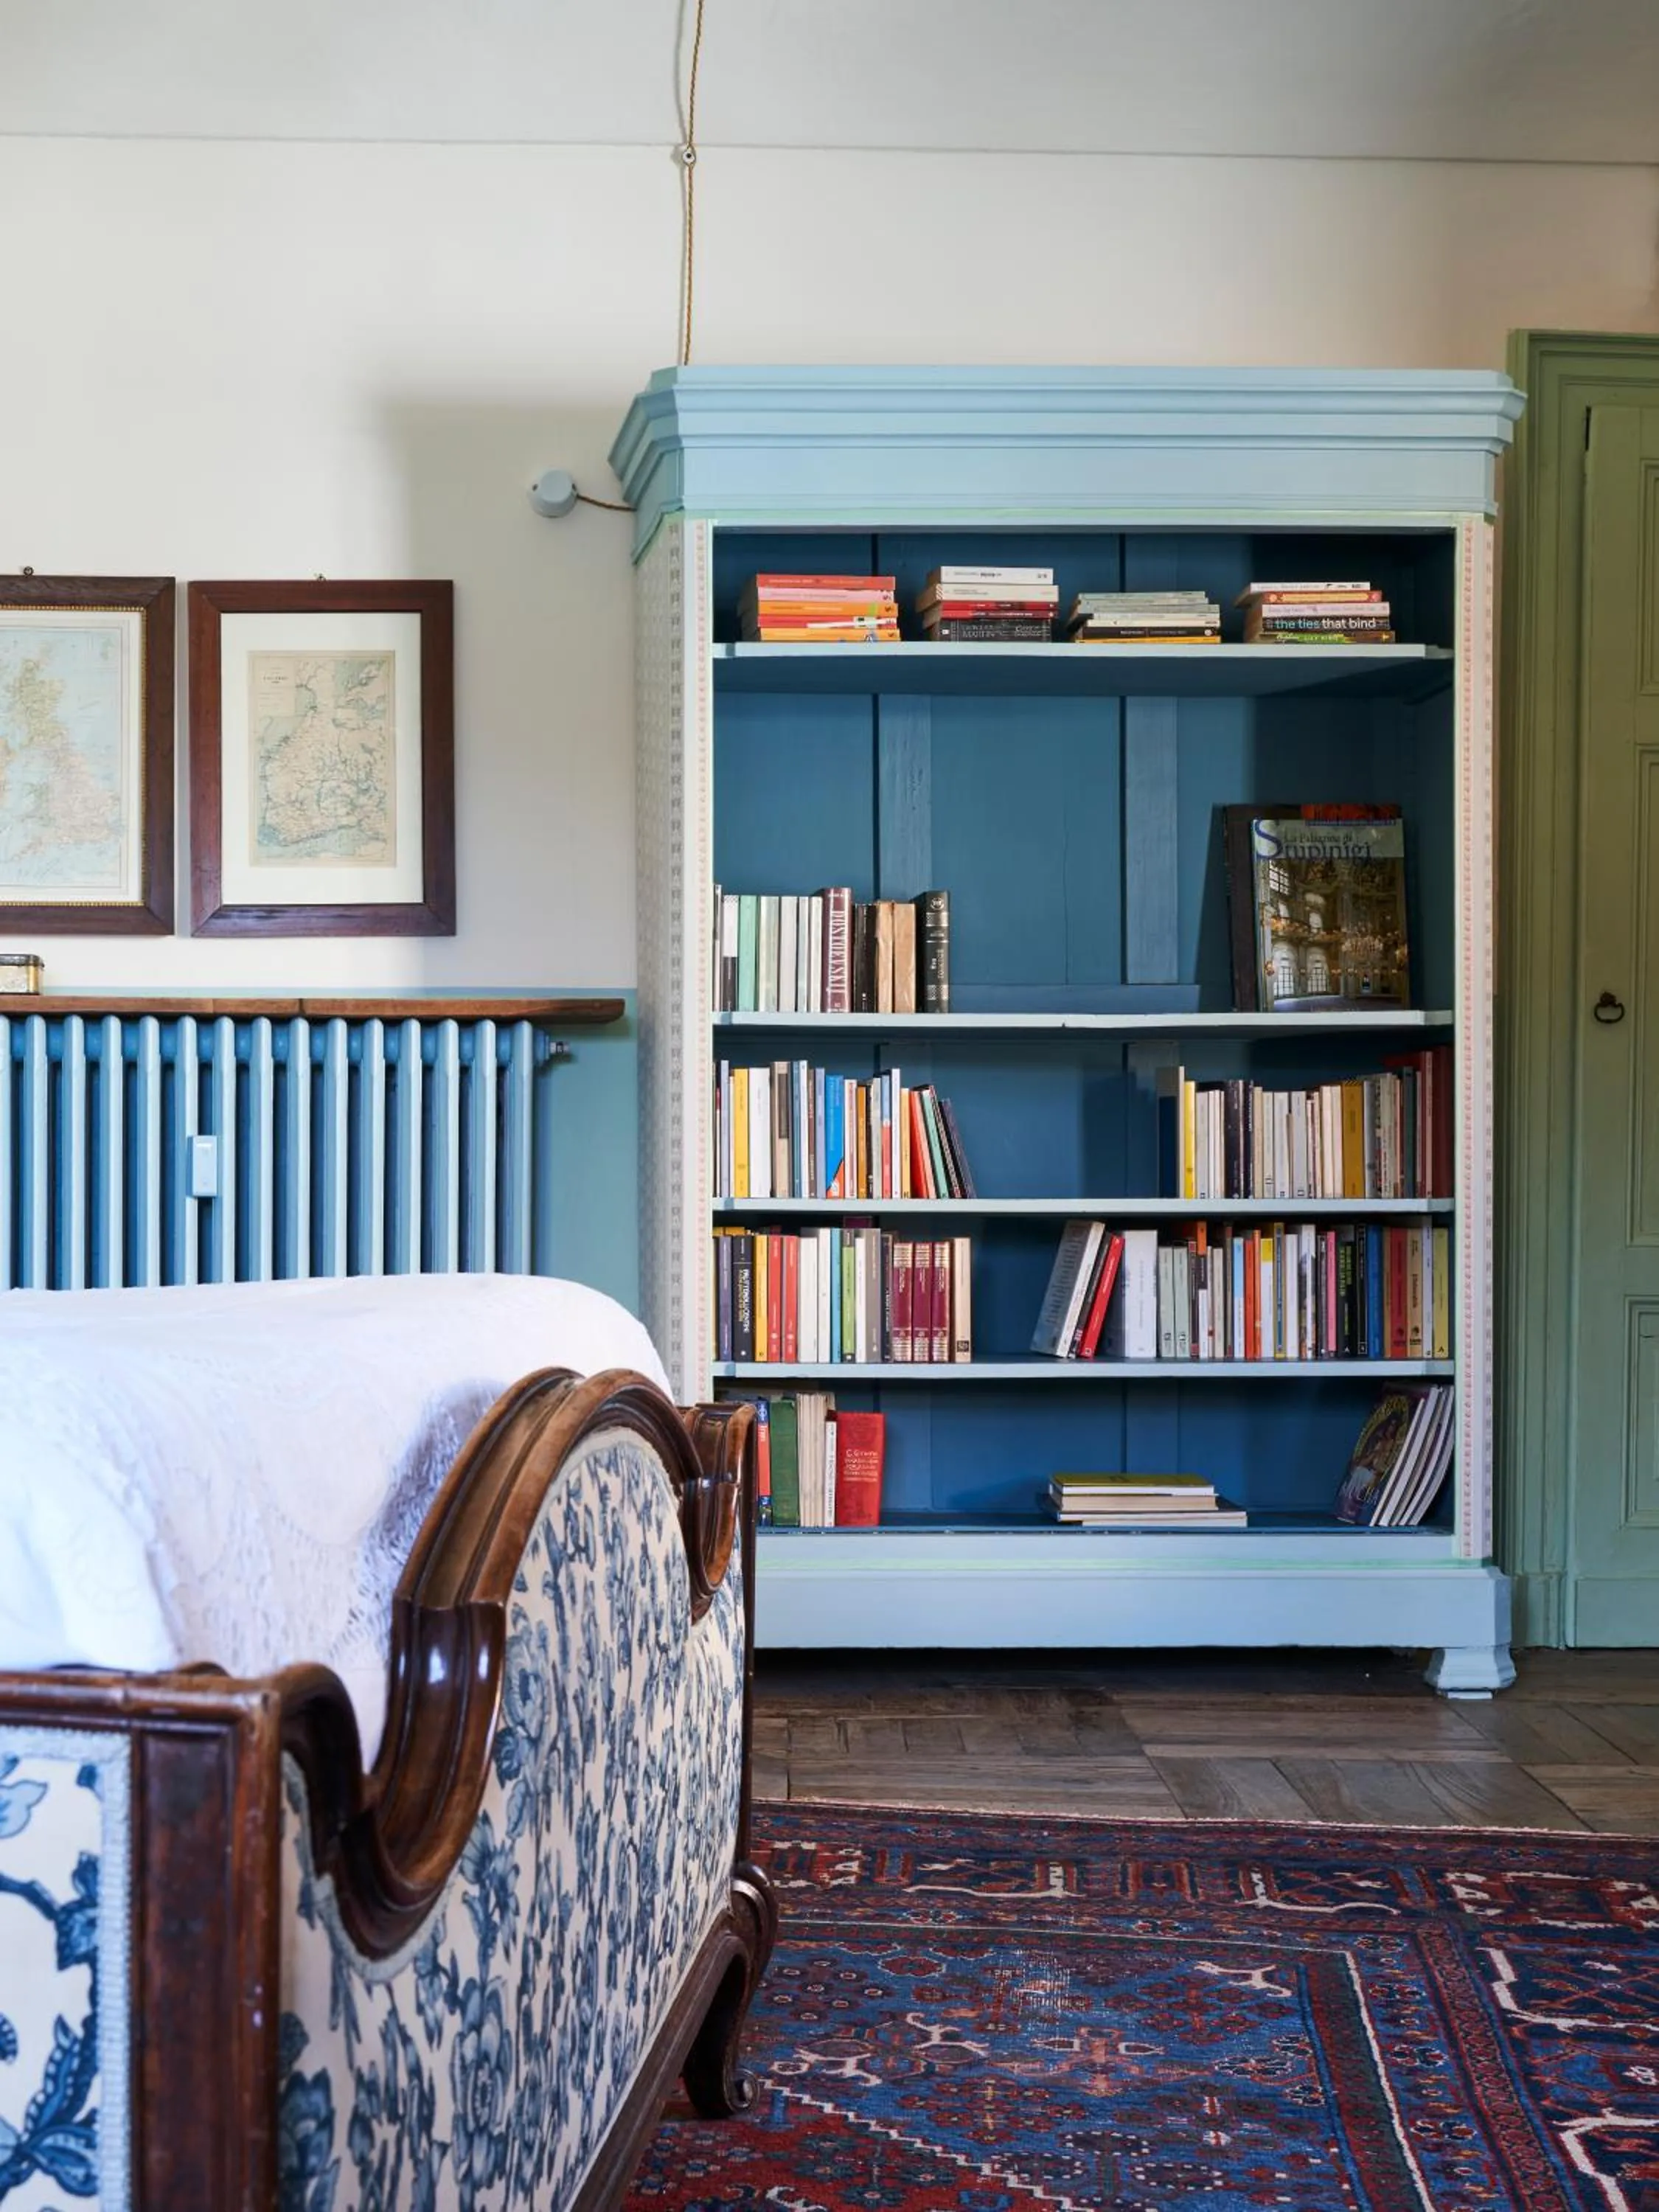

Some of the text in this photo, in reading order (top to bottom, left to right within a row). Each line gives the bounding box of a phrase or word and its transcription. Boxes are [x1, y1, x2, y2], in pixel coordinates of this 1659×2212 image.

[1275, 617, 1377, 629] the ties that bind
